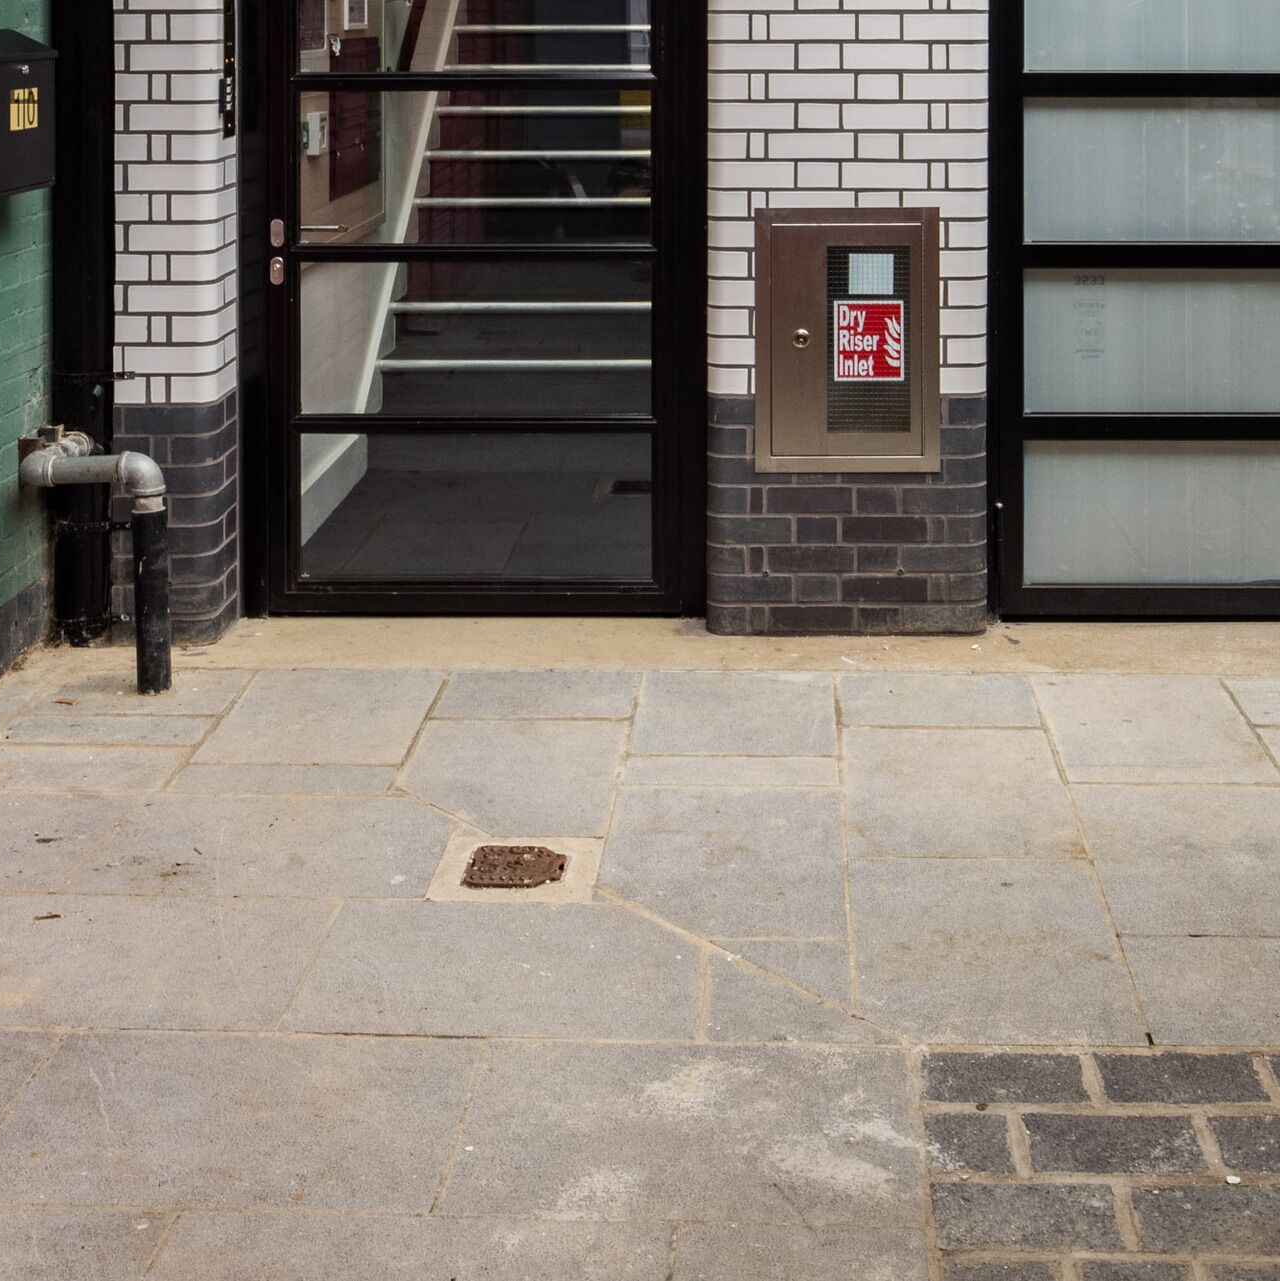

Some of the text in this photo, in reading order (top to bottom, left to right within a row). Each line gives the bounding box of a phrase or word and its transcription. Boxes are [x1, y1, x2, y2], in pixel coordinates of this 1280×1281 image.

[839, 305, 866, 332] Dry
[839, 329, 880, 352] Riser
[839, 354, 874, 376] Inlet
